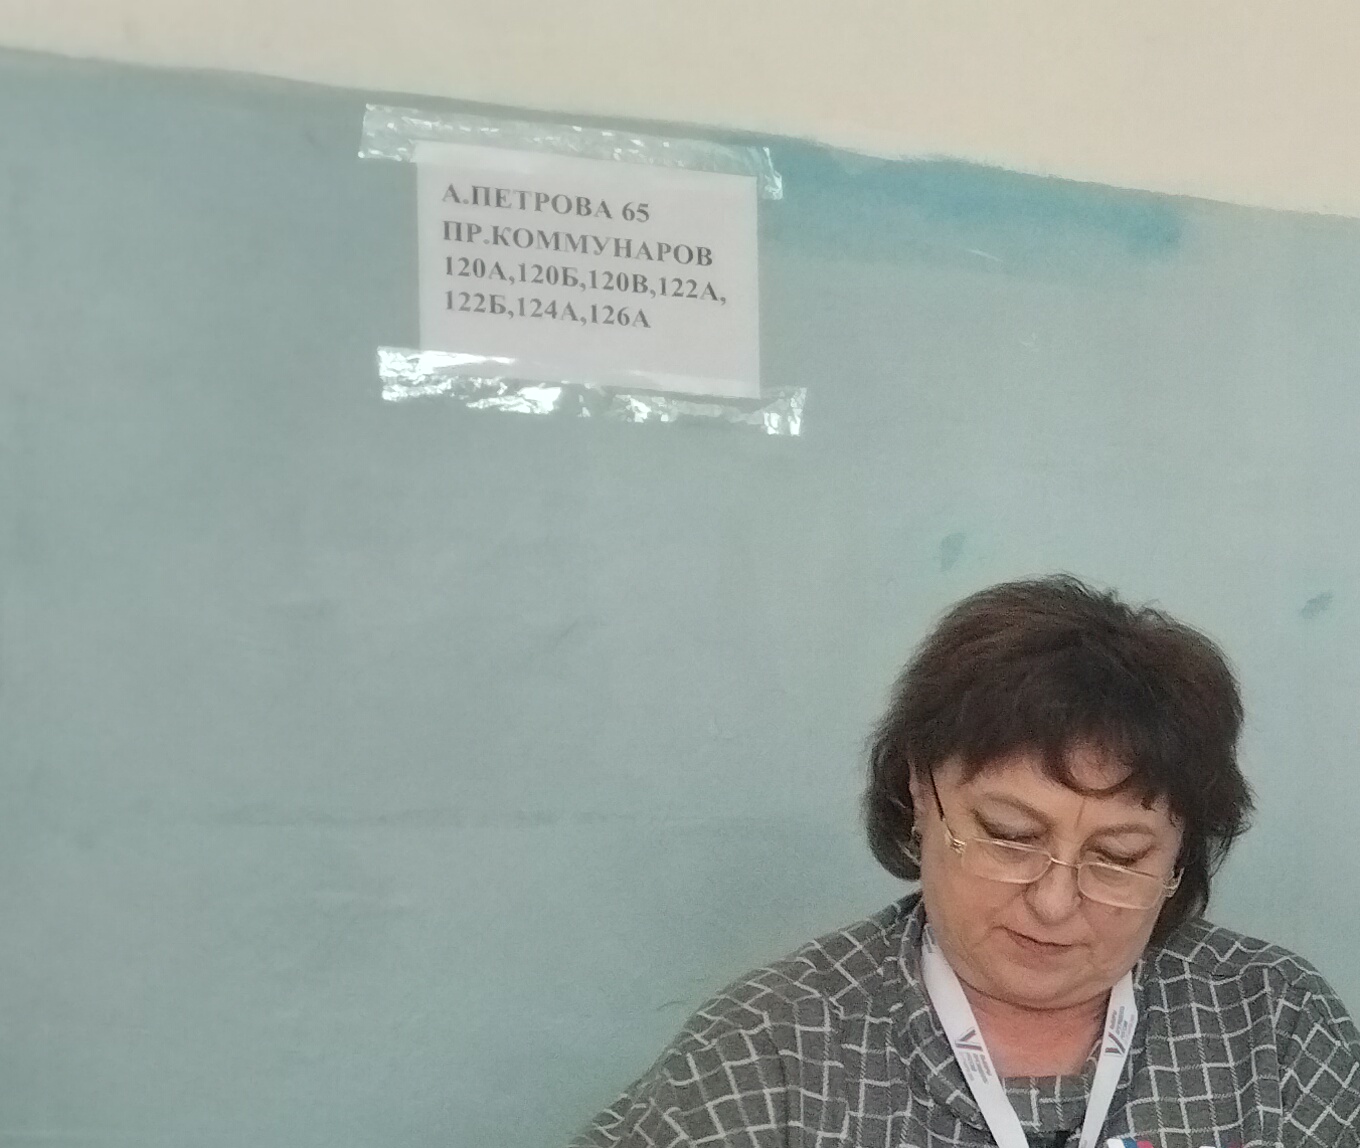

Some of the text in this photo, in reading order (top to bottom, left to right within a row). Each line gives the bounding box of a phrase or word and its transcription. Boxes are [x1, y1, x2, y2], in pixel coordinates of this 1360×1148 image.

[441, 183, 650, 223] А.ПЕТРОВА 65
[442, 220, 714, 268] ПР.КОММУНАРОВ
